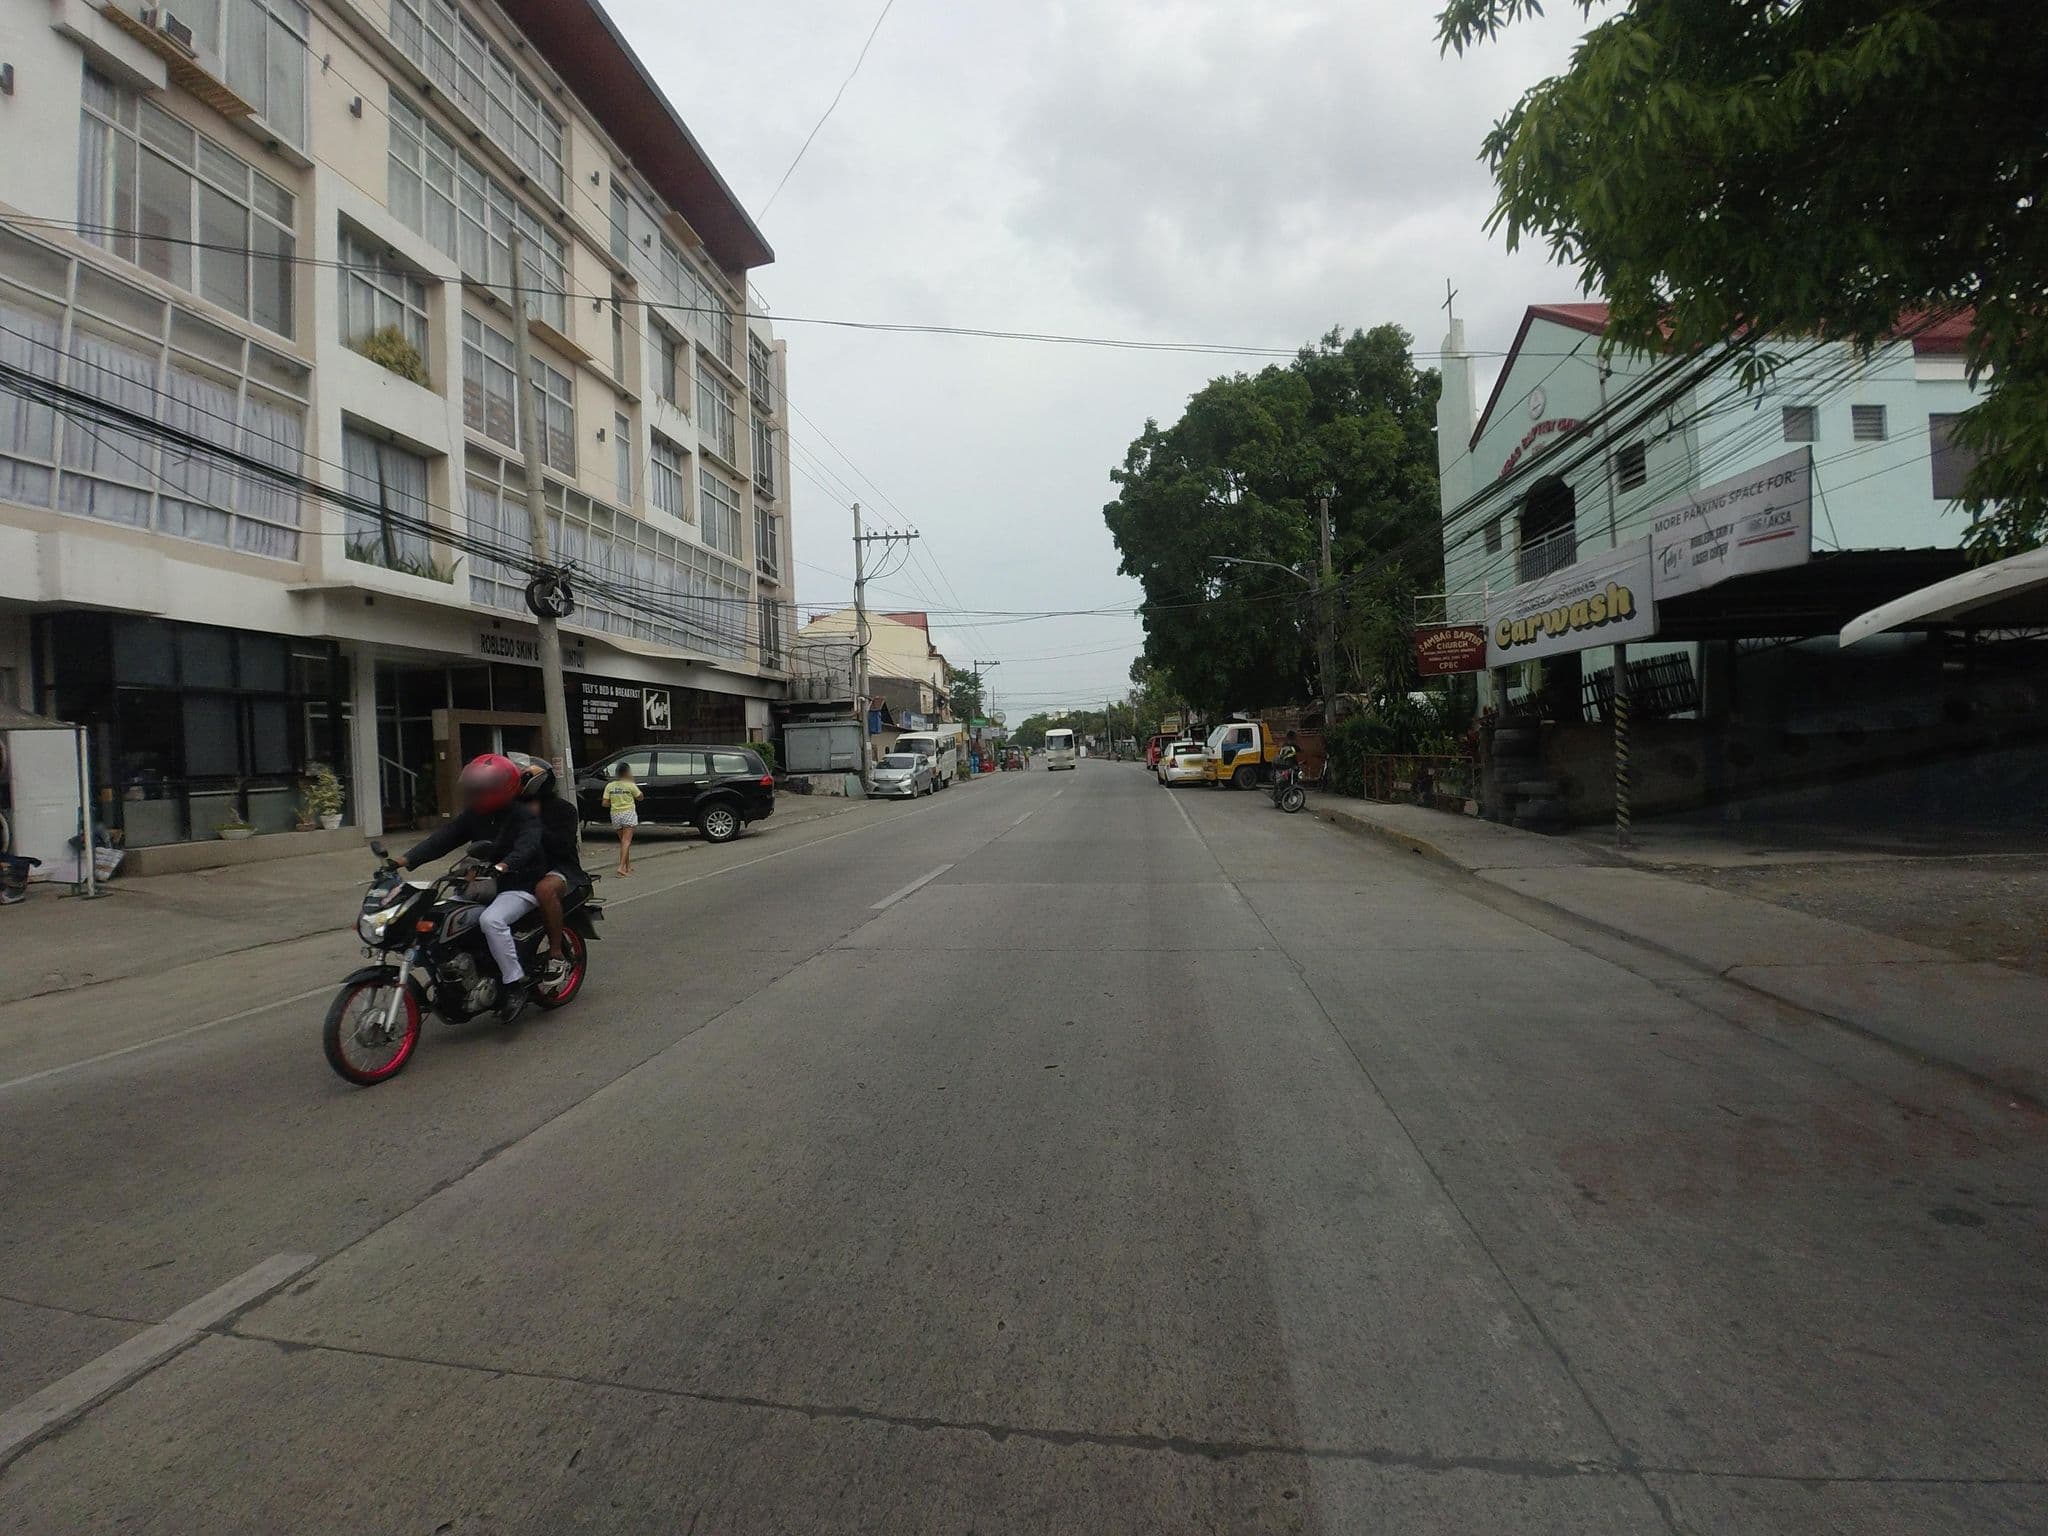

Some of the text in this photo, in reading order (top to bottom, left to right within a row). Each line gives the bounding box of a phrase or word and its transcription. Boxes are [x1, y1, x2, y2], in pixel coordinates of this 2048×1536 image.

[1655, 470, 1797, 533] MORE PARKING SPACE FOR:
[1495, 581, 1636, 650] Carwash
[480, 633, 514, 658] ROBLEDO
[516, 640, 533, 660] SKIN
[1418, 630, 1484, 653] SAMBAG BAPTIST
[1436, 640, 1469, 650] CHURCH
[582, 683, 599, 694] TELY'S
[599, 685, 610, 695] BED
[615, 687, 641, 698] BREAKFAST
